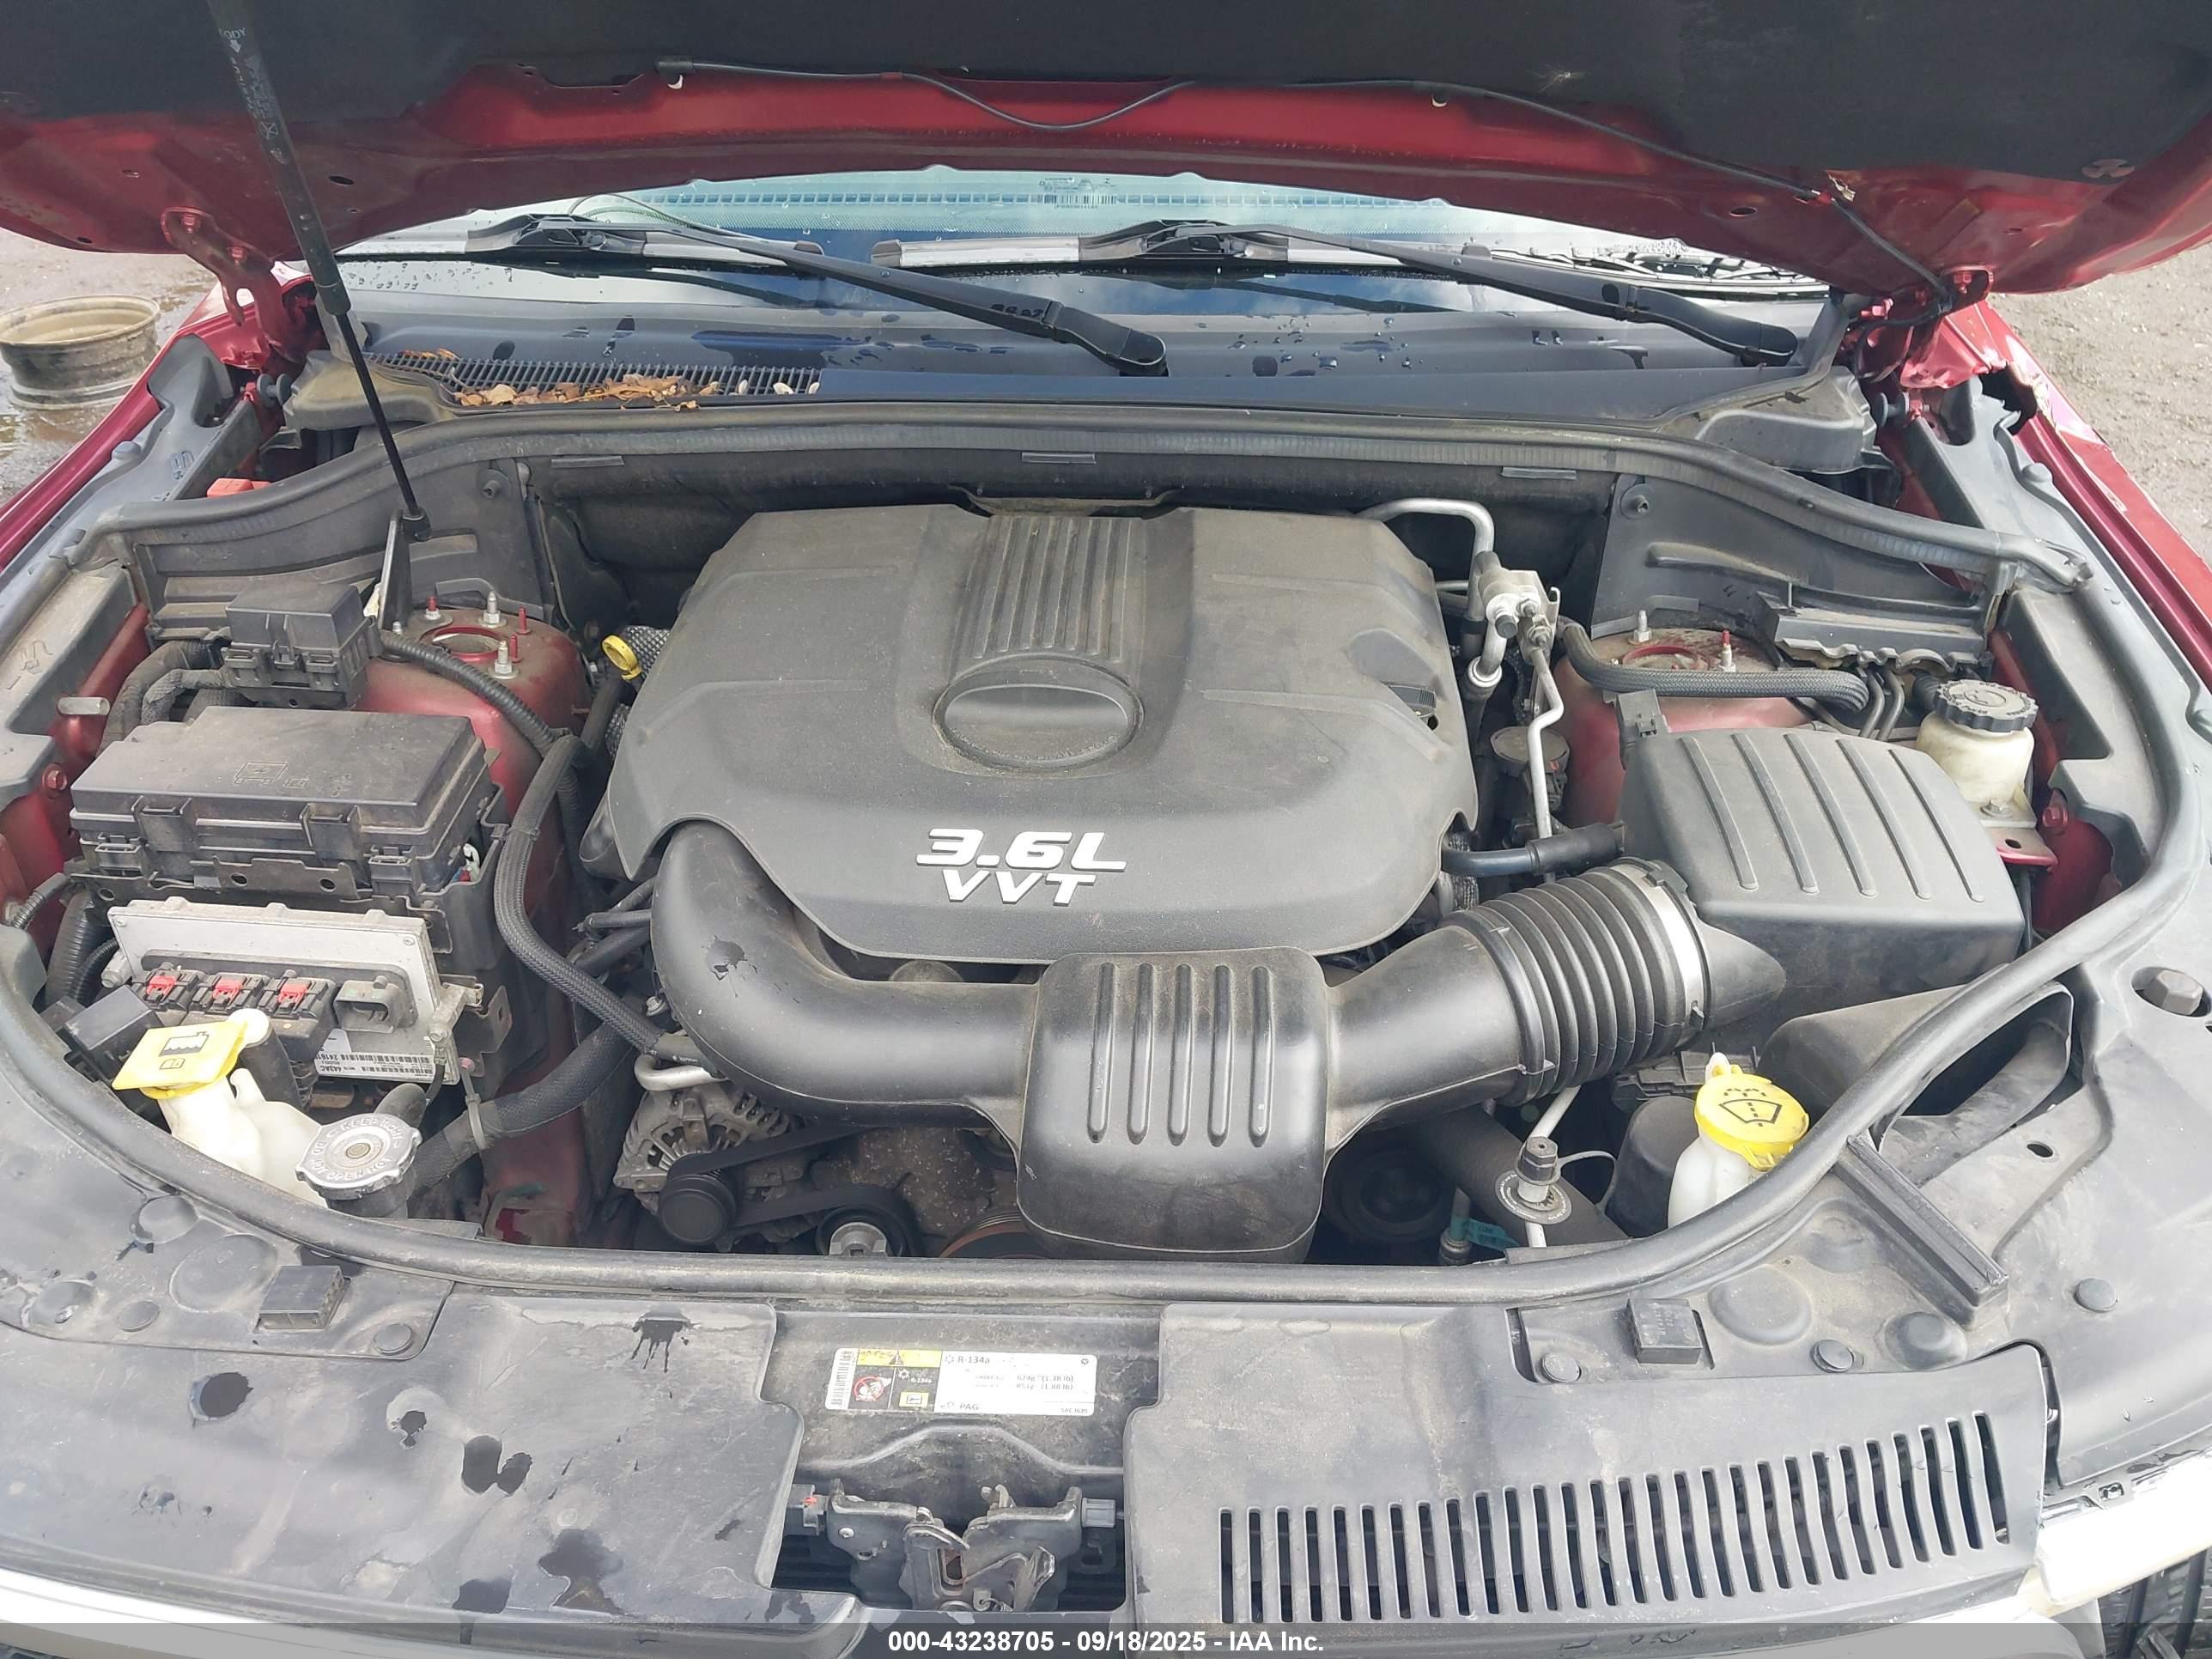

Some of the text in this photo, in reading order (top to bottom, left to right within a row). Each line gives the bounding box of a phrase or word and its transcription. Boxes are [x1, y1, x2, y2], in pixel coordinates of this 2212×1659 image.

[915, 828, 1127, 872] 3.6L
[942, 869, 1097, 907] VVT
[957, 1355, 990, 1364] R-134a
